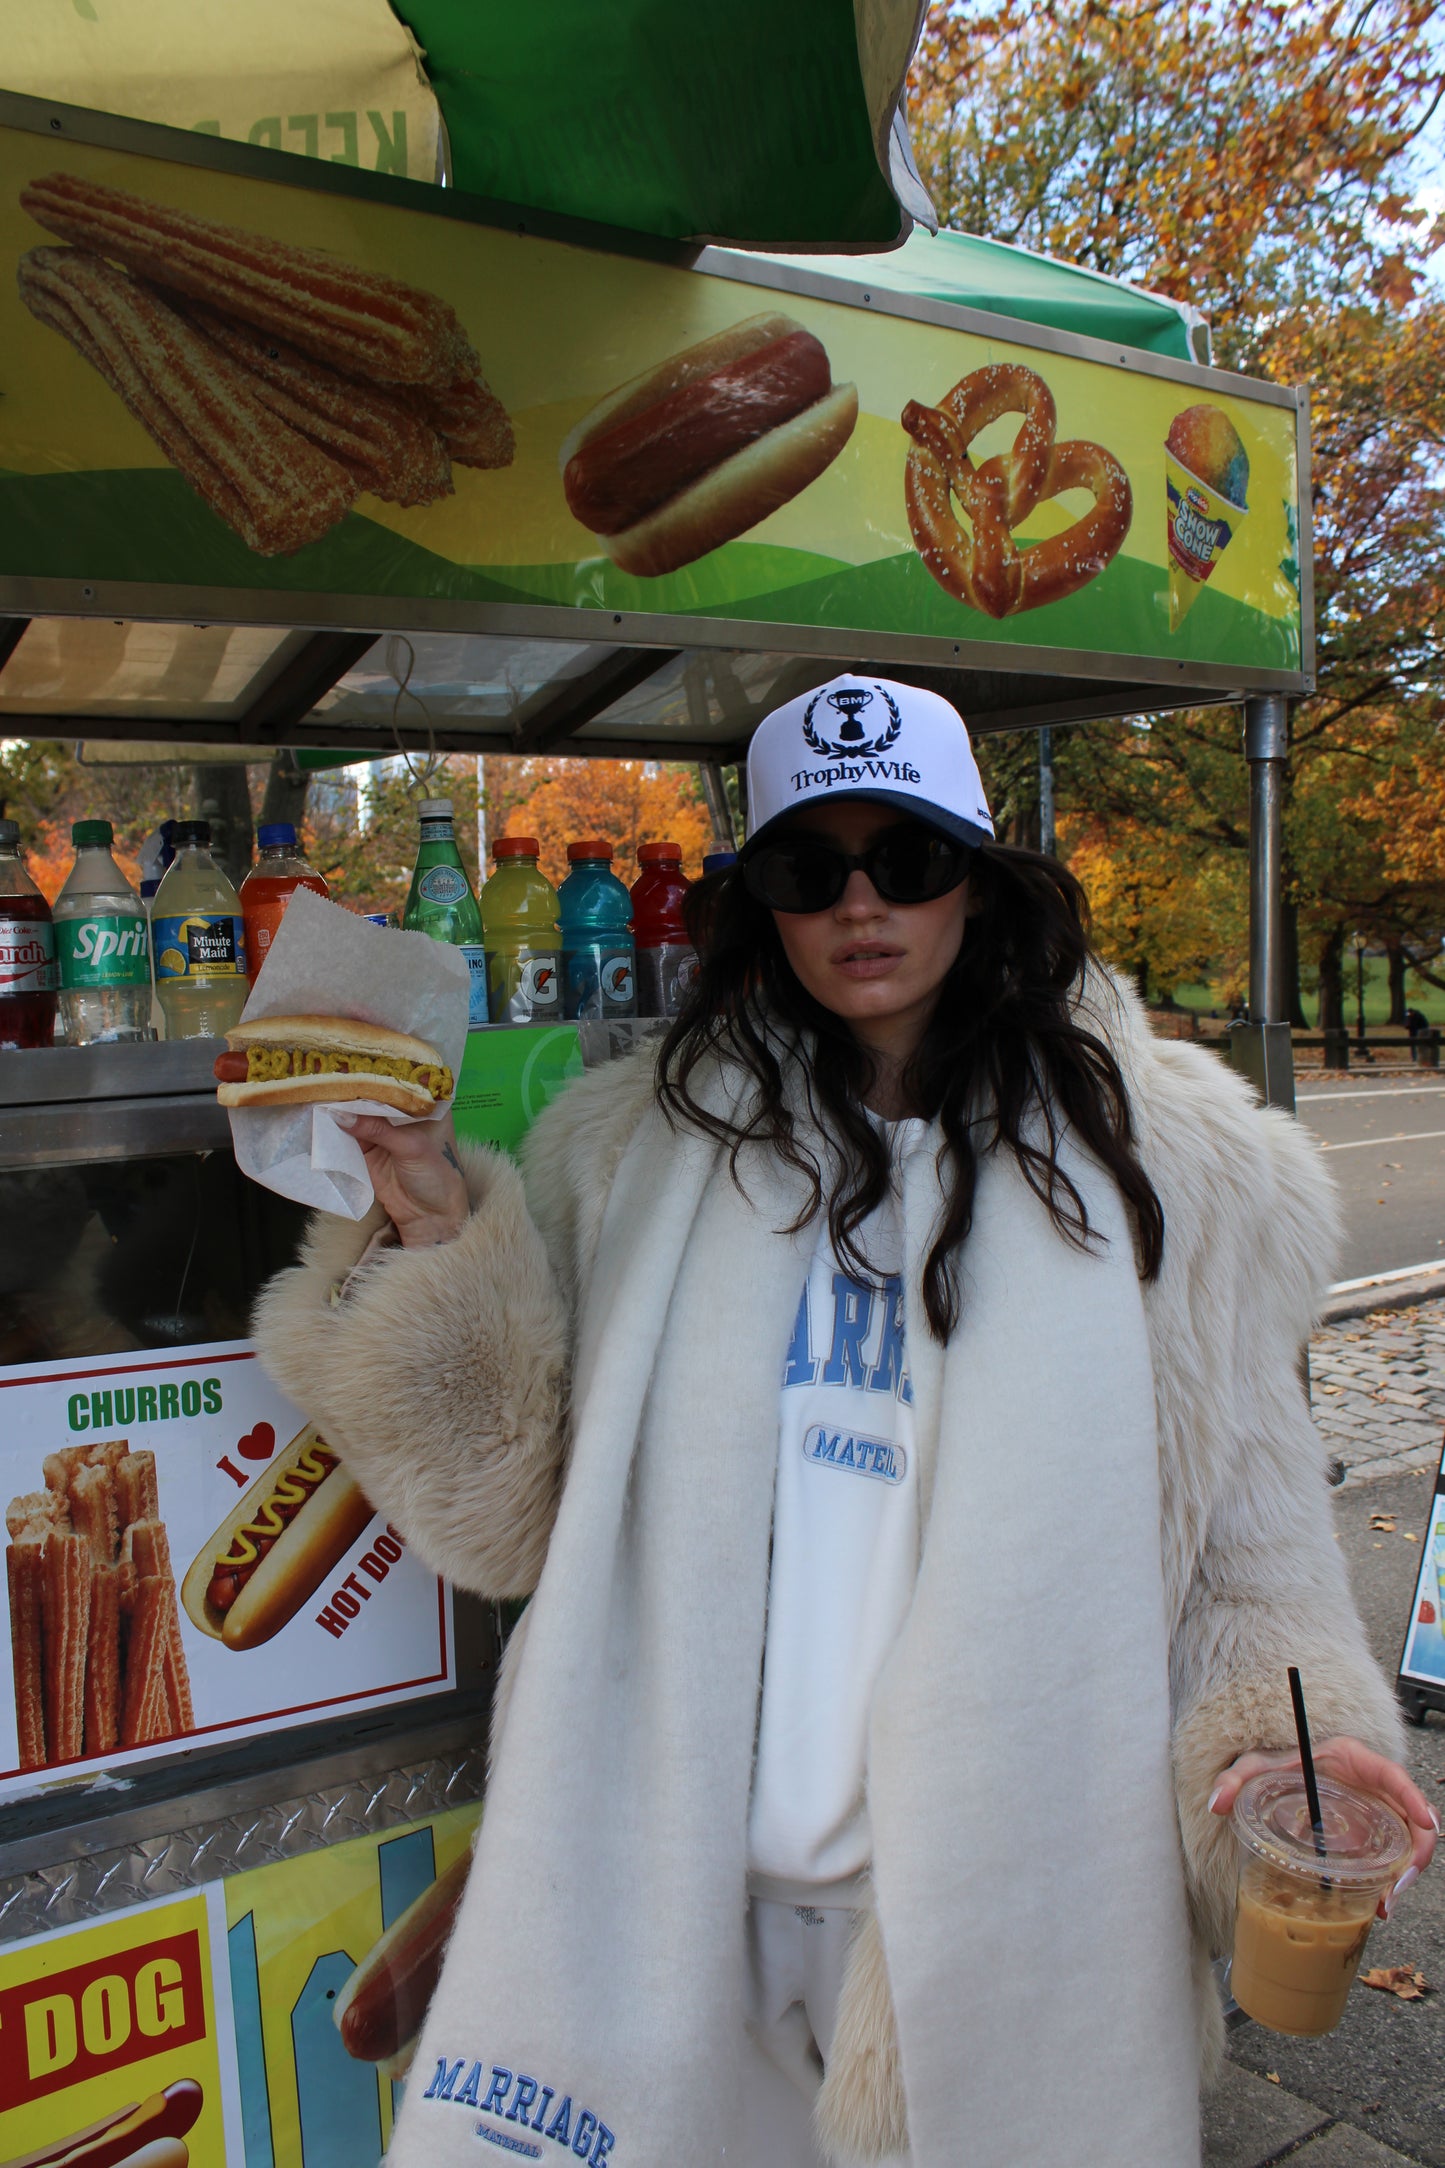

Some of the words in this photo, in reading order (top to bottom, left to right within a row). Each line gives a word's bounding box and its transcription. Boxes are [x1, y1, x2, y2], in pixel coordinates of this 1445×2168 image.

[1175, 517, 1214, 560] CONE
[1179, 499, 1220, 546] SNOW
[838, 696, 863, 706] BM
[72, 921, 148, 966] Sprit
[193, 936, 232, 948] Minute
[199, 947, 228, 959] Maid
[68, 1377, 224, 1432] CHURROS
[315, 1571, 372, 1640] HOT
[358, 1522, 408, 1584] DO
[24, 1957, 186, 2080] DOG
[423, 2055, 616, 2168] MARRIAGE
[475, 2123, 541, 2159] MATERIAL
